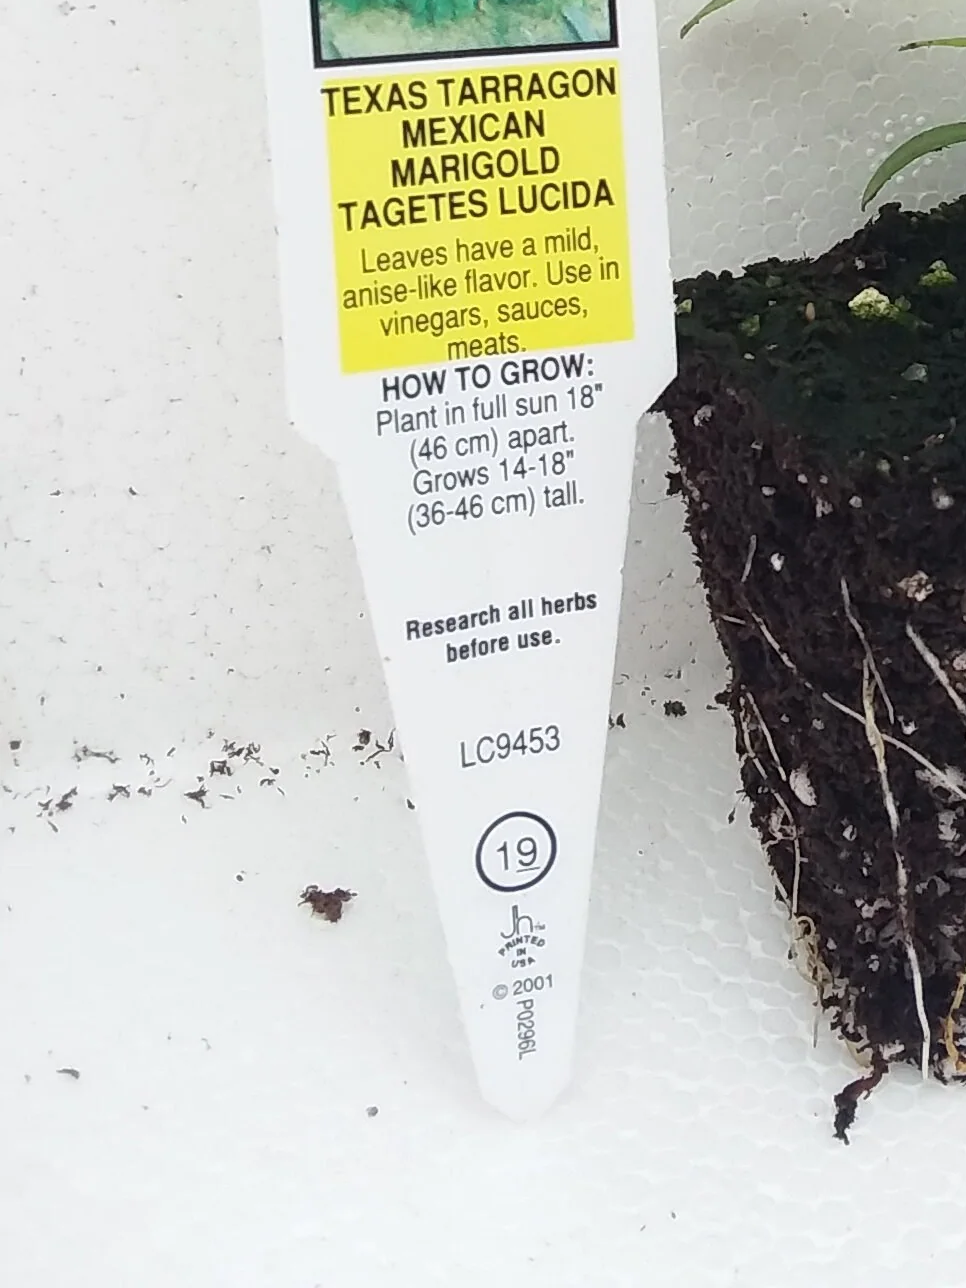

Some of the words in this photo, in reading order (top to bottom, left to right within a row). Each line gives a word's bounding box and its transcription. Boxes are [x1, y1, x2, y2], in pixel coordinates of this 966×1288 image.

[321, 81, 427, 116] TEXAS
[437, 67, 617, 107] TARRAGON
[402, 110, 545, 148] MEXICAN
[391, 146, 559, 188] MARIGOLD
[339, 189, 487, 231] TAGETES
[499, 179, 614, 215] LUCIDA
[361, 246, 447, 273] Leaves
[456, 238, 513, 262] have
[522, 237, 535, 256] a
[544, 226, 599, 253] mild,
[343, 275, 457, 308] anise-like
[465, 269, 538, 294] flavor.
[547, 261, 591, 285] Use
[599, 257, 619, 280] in
[380, 306, 488, 336] vinegars,
[497, 296, 588, 321] sauces,
[448, 334, 526, 360] meats.
[382, 370, 446, 402] HOW
[455, 365, 491, 390] TO
[501, 354, 594, 385] GROW:
[377, 409, 437, 436] Plant
[445, 403, 463, 425] in
[472, 394, 506, 421] full
[515, 393, 557, 416] sun
[567, 383, 602, 409] 18"
[410, 437, 447, 469] (46
[455, 427, 498, 457] cm)
[508, 421, 574, 452] apart.
[413, 466, 489, 495] Grows
[500, 450, 573, 481] 14-18"
[407, 494, 483, 535] (36-46
[491, 486, 535, 516] cm)
[543, 481, 584, 508] tall.
[406, 604, 500, 640] Research
[508, 599, 533, 619] all
[542, 593, 597, 614] herbs
[446, 633, 509, 662] before
[518, 628, 560, 649] use.
[461, 725, 560, 768] LC9453
[497, 837, 540, 870] 19
[498, 935, 545, 956] PRINTED
[512, 957, 535, 968] USA
[517, 948, 526, 956] IN
[513, 974, 553, 995] 2001
[517, 999, 536, 1060] P0296L
